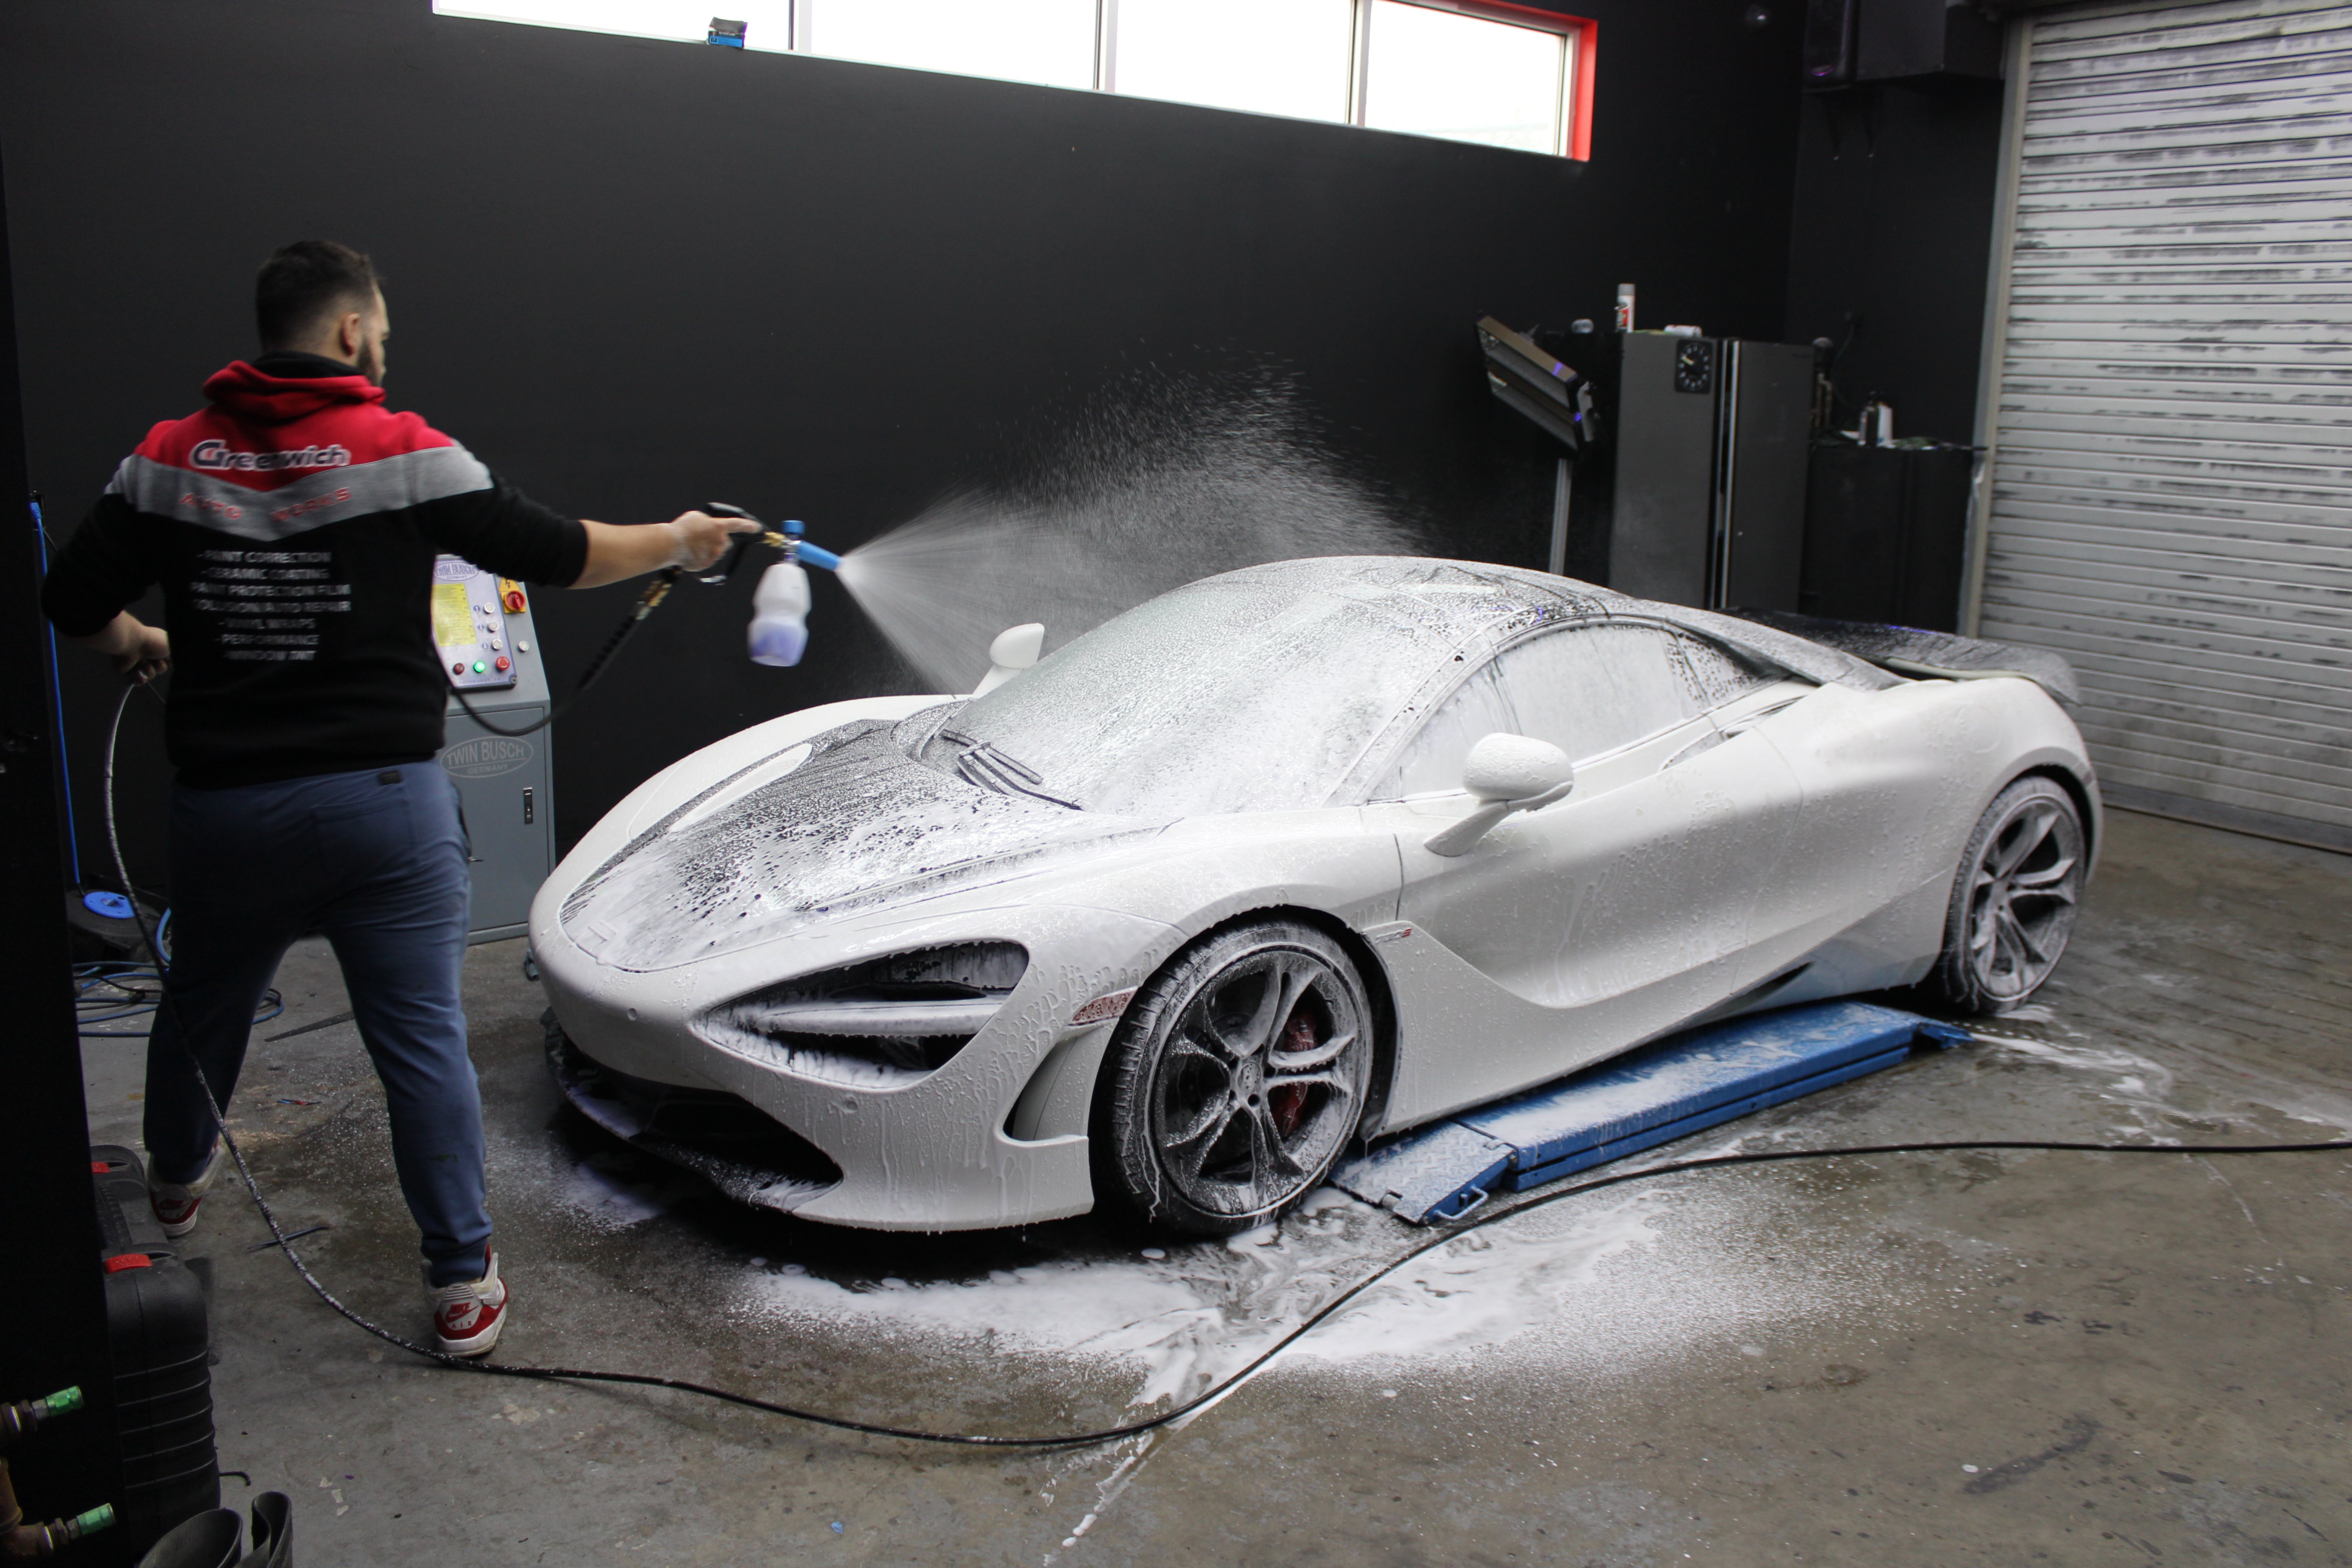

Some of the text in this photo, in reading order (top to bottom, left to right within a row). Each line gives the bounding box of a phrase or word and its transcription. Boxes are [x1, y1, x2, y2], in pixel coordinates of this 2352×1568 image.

[189, 439, 352, 471] Greenwich
[180, 486, 352, 522] AUTO WORKS
[451, 563, 475, 575] BUSCH
[446, 740, 524, 766] TWIN BUSCH
[467, 763, 508, 775] GERMANY
[449, 1302, 471, 1314] NIKE
